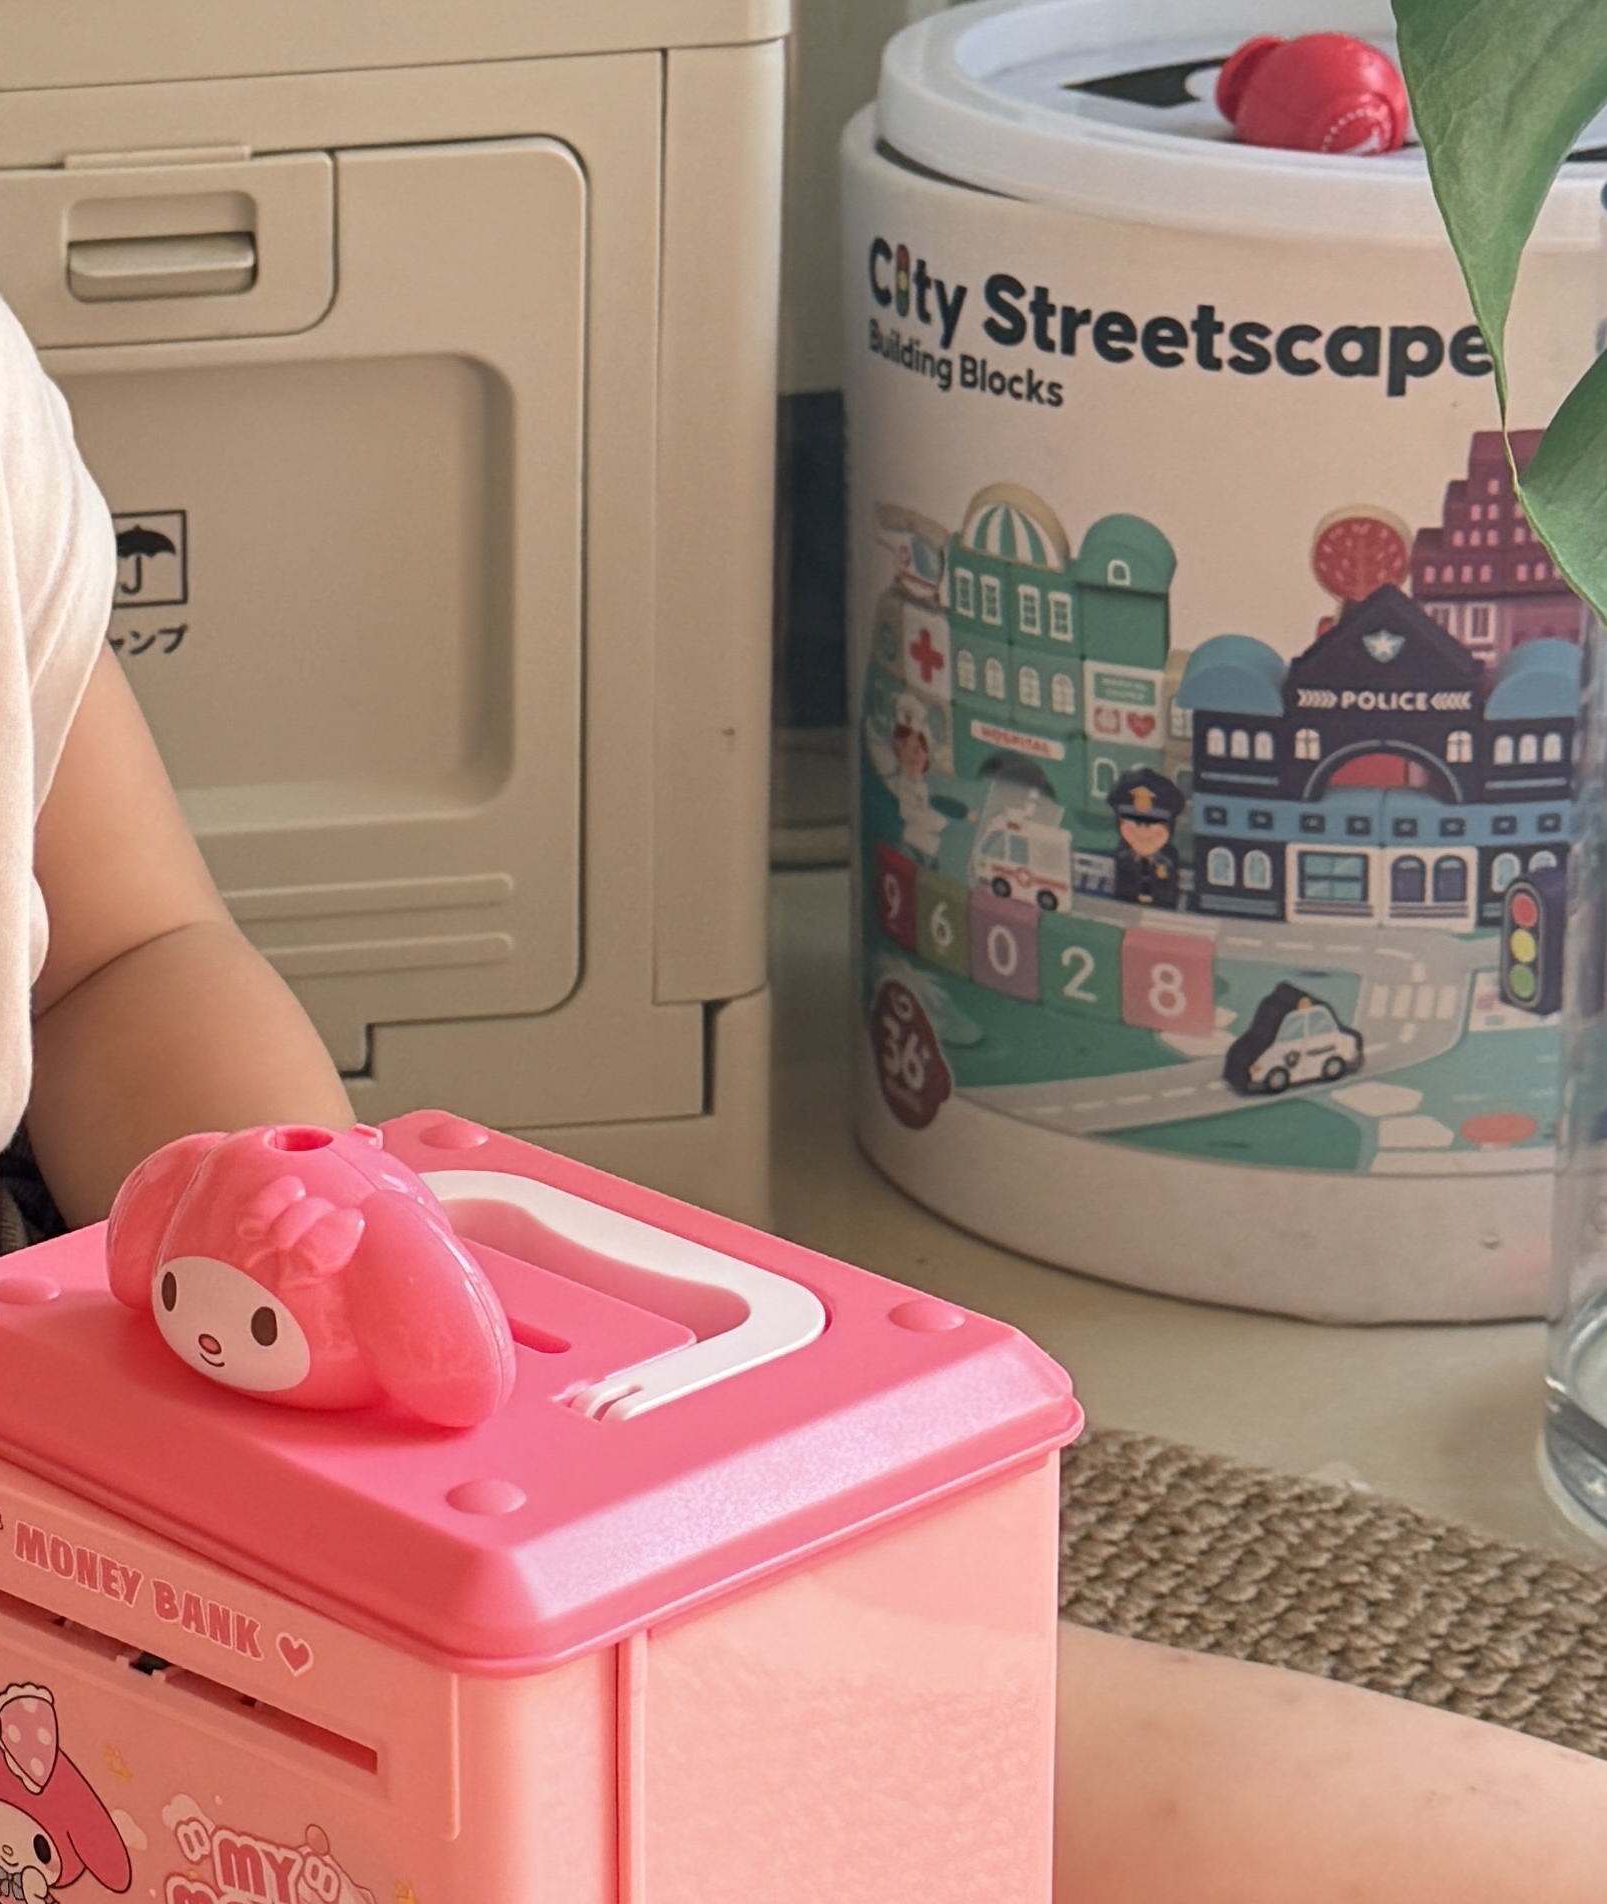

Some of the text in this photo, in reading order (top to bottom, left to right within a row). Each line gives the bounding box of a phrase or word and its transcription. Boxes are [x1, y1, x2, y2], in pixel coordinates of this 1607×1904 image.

[869, 237, 1495, 397] City Streetscape
[869, 318, 1064, 407] Building Blocks
[1340, 690, 1429, 712] POLICE
[883, 873, 1187, 1016] 9 6 0 2 8
[13, 1521, 263, 1660] MONEY BANK
[211, 1828, 300, 1904] MY
